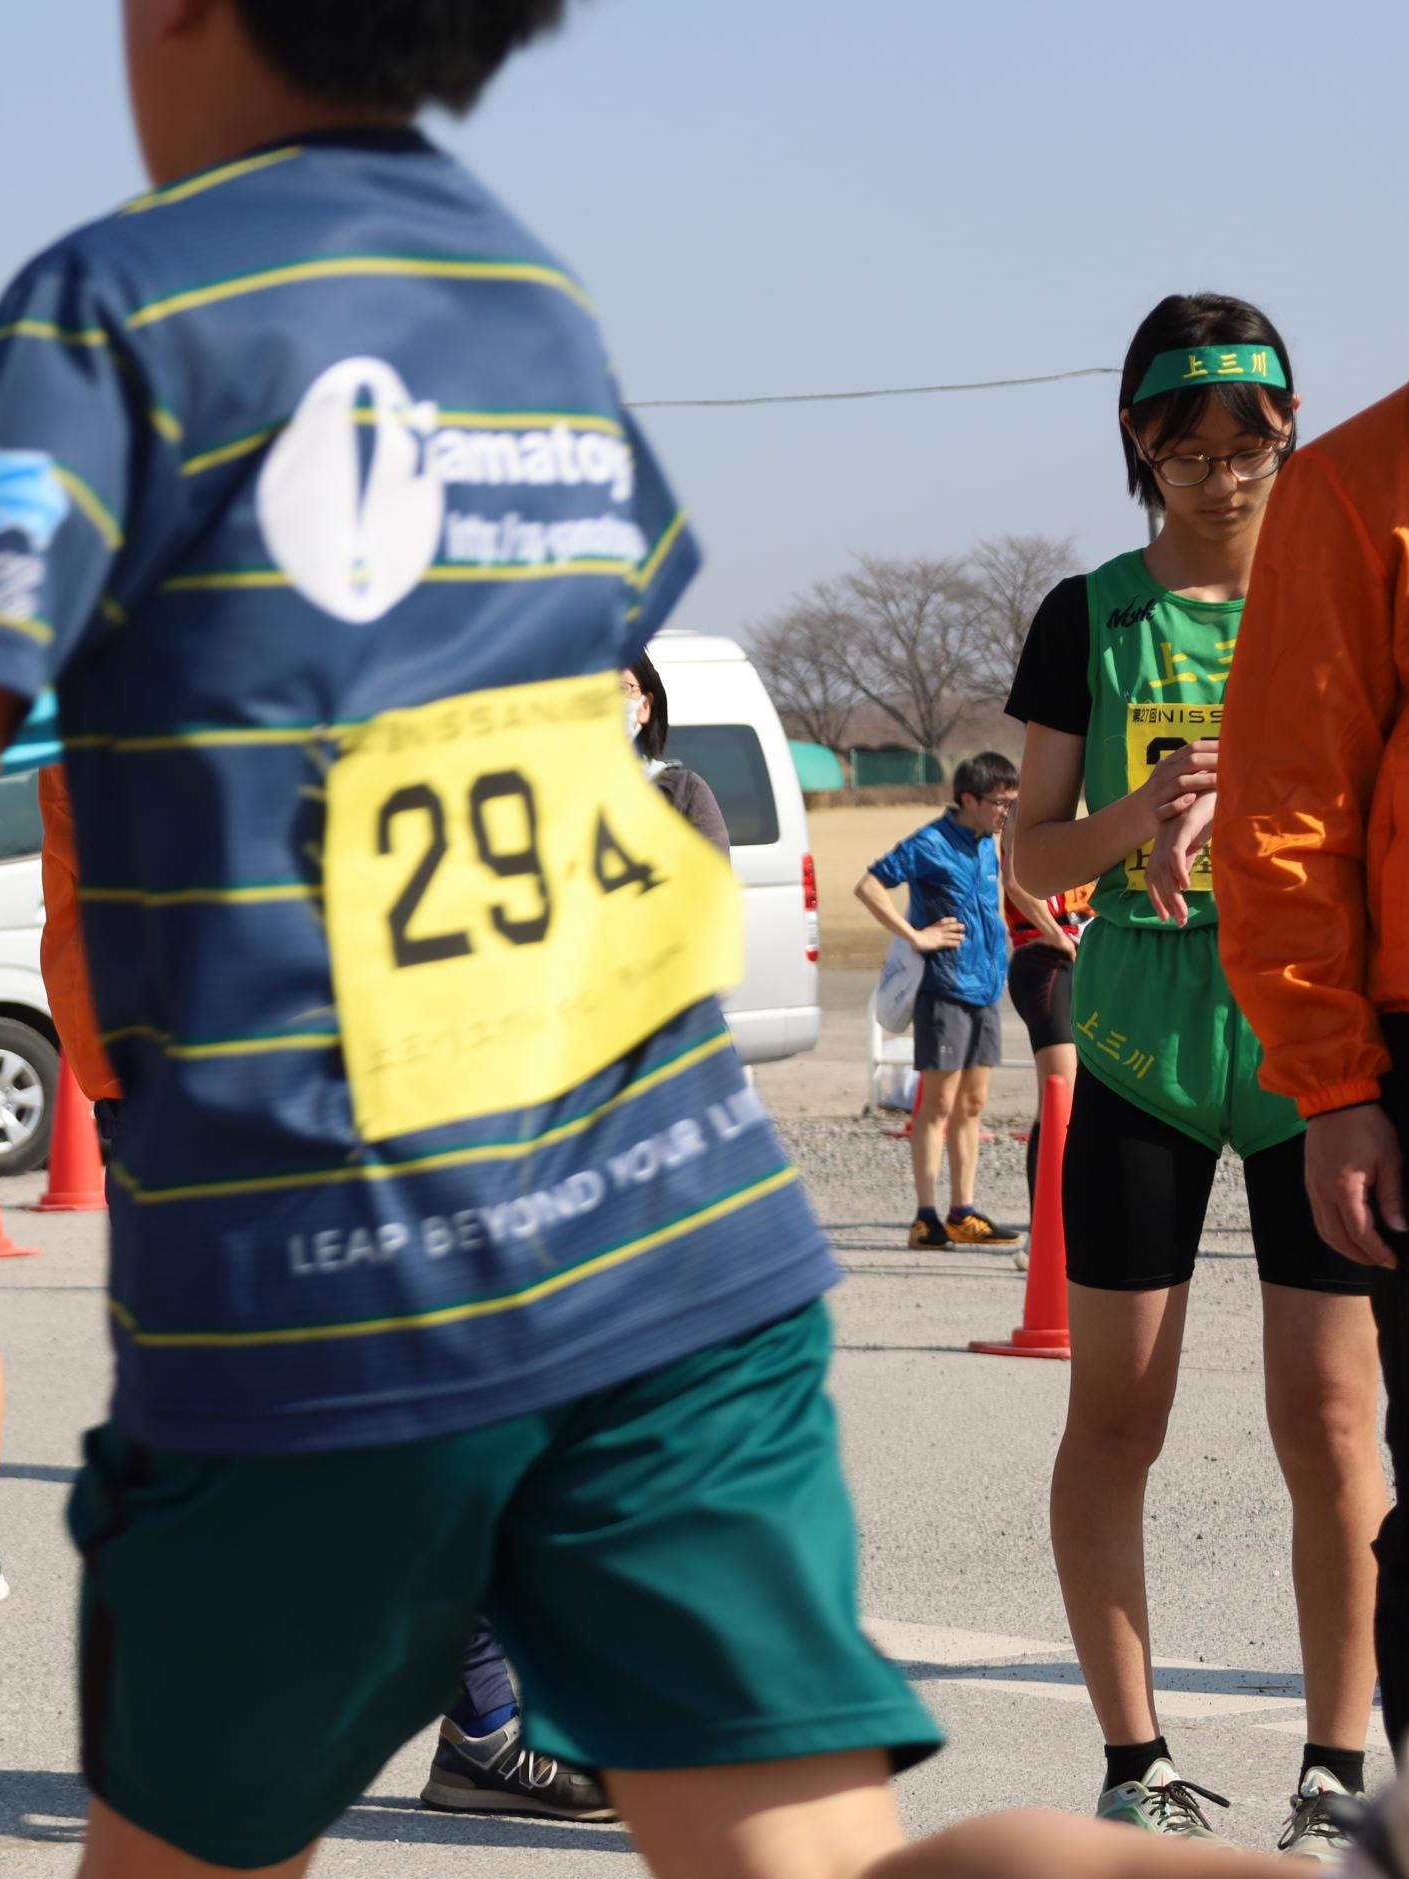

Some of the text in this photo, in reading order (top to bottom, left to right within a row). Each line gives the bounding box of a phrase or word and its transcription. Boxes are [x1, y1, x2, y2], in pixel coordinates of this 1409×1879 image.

[1182, 351, 1268, 379] 上三川
[1076, 1009, 1156, 1079] 上三川
[289, 1222, 410, 1275] LEAP
[421, 1168, 606, 1258] BEYOND
[607, 1117, 709, 1186] YOUR
